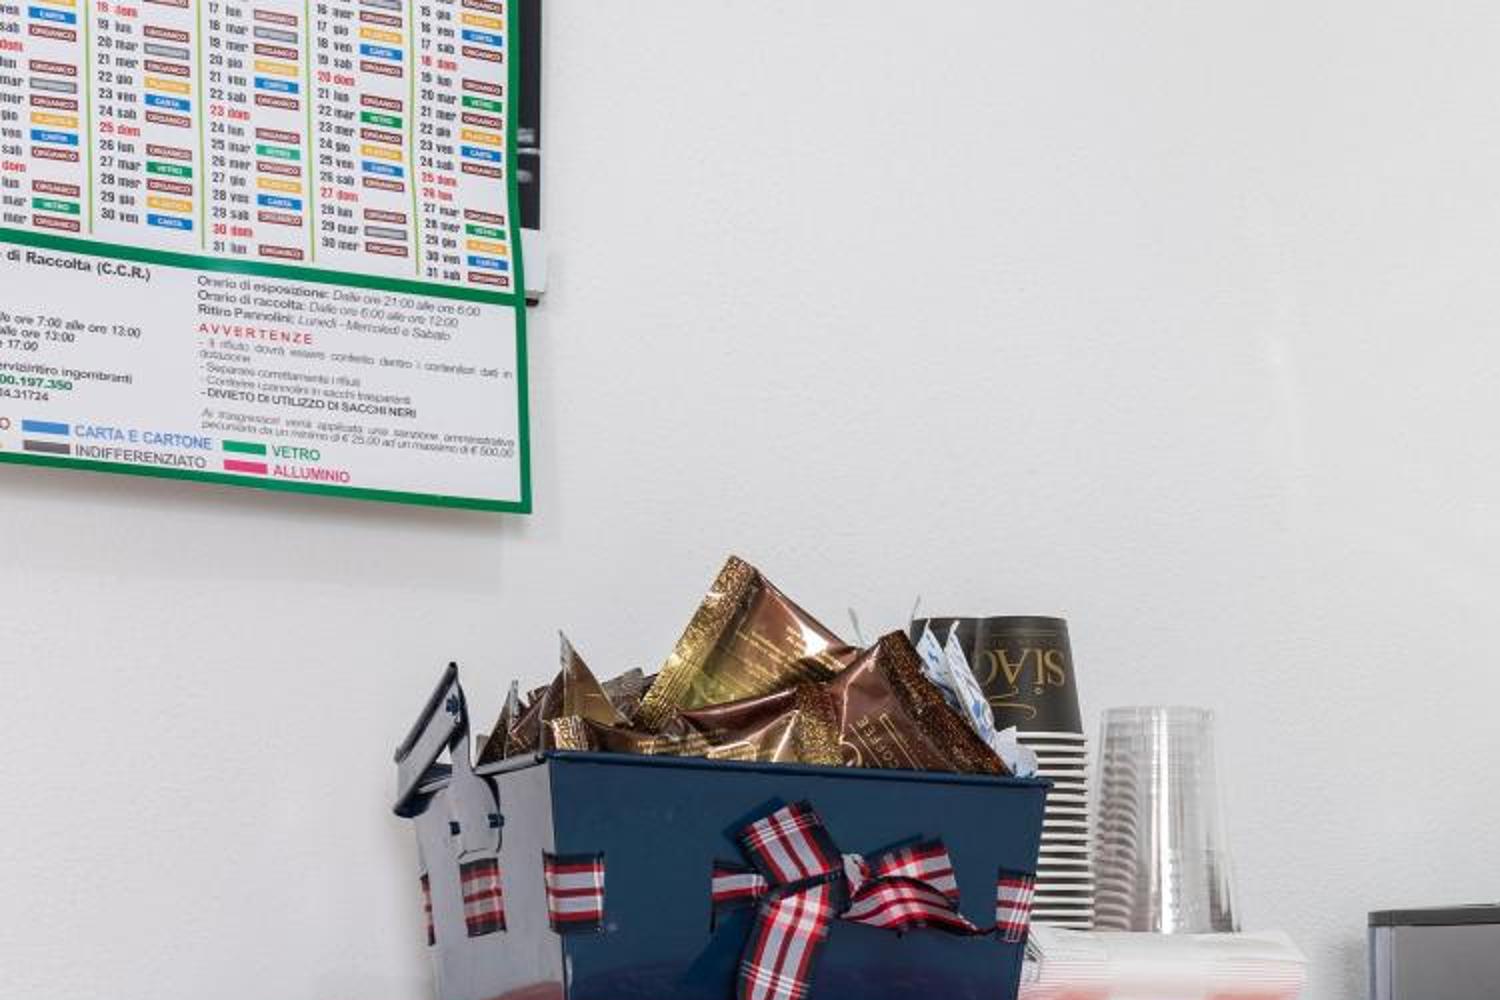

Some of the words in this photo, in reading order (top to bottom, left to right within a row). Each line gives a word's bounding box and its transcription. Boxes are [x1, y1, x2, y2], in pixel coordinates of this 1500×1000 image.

[7, 250, 20, 260] di
[26, 251, 91, 271] Raccolta
[97, 262, 151, 281] (C.C.R.)
[197, 275, 236, 289] Orario
[197, 289, 236, 303] Orario
[0, 374, 73, 391] 00.197.350
[207, 388, 254, 403] DIVIETO
[272, 396, 325, 409] UTILIZZO
[341, 402, 386, 415] SACCHI
[75, 425, 125, 441] CARTA
[143, 432, 212, 451] CARTONE
[75, 444, 207, 469] INDIFFERENZIATO
[272, 445, 321, 461] VETRO
[273, 464, 351, 483] ALLUMINIO
